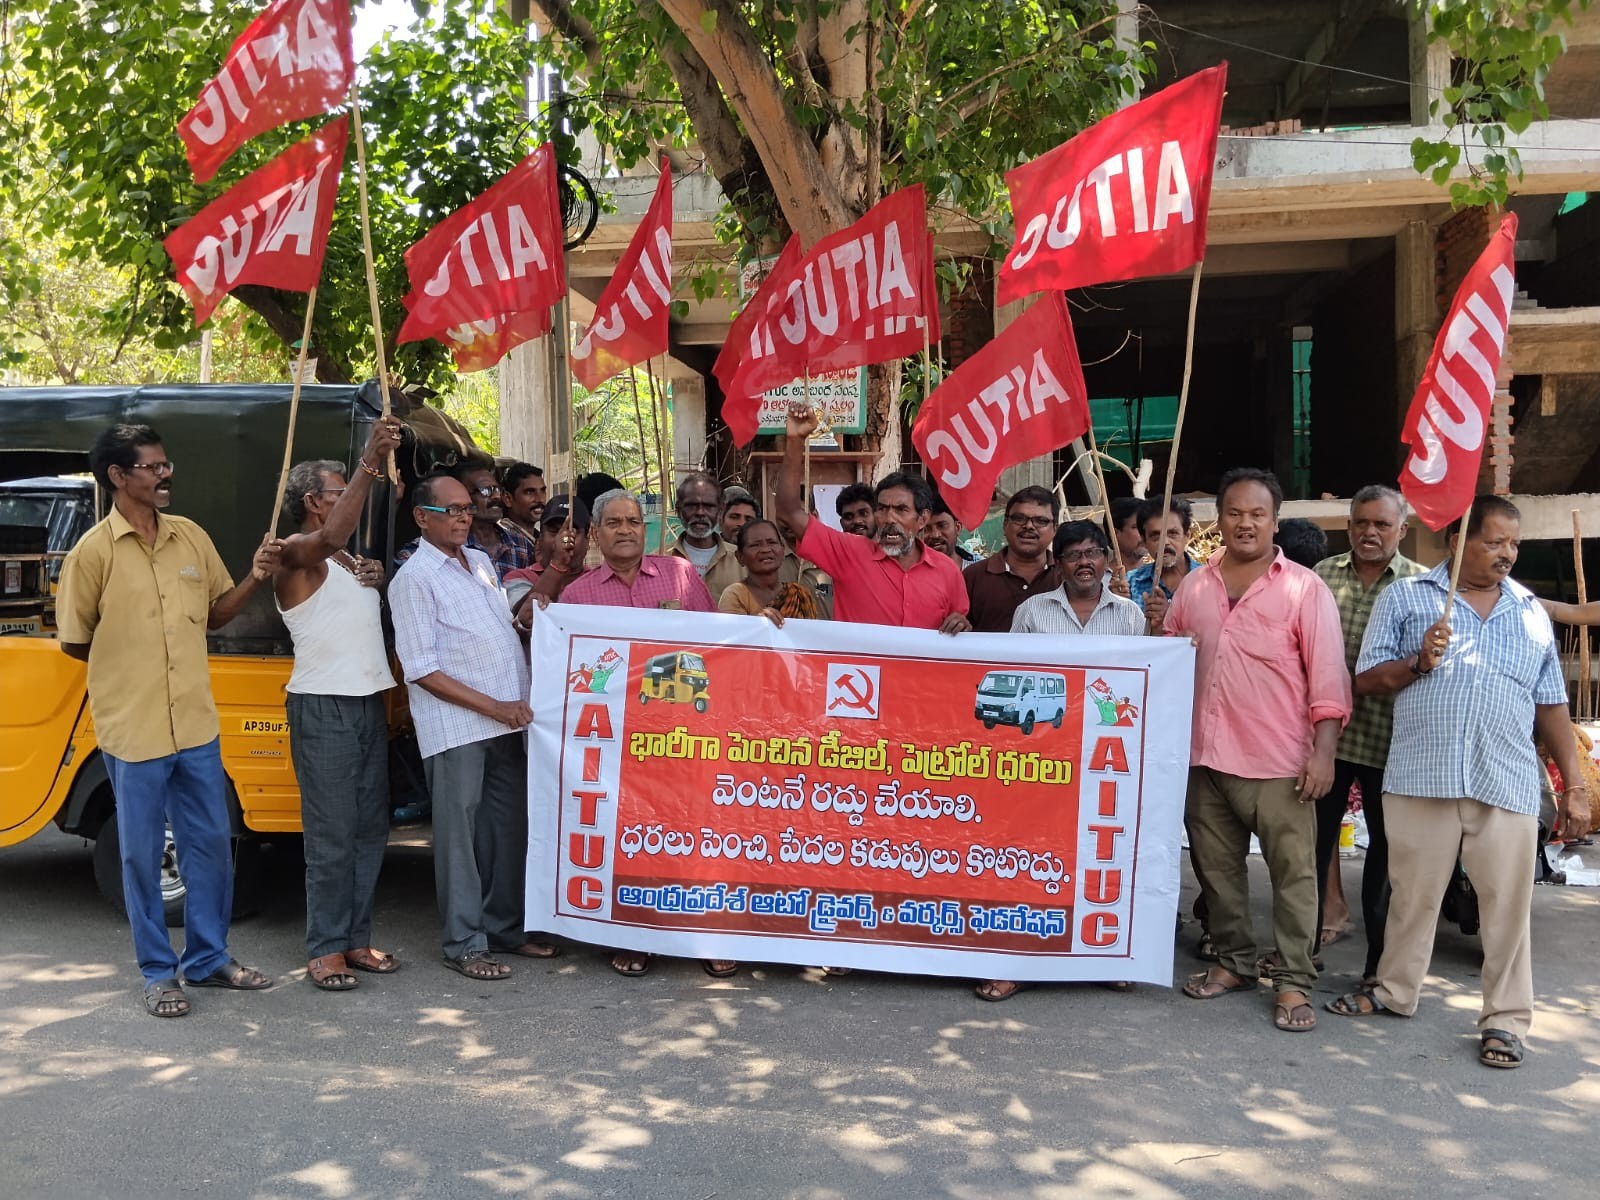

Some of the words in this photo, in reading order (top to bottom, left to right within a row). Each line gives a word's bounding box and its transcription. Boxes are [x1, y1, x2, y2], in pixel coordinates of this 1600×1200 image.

[629, 726, 721, 762] భారీగా
[727, 731, 812, 766] పెంచిన
[901, 741, 992, 781] పెట్రోల్
[996, 750, 1073, 786] ధరలు
[567, 703, 615, 912] AITUC
[712, 773, 806, 810] వెంటనే
[811, 782, 868, 827] రద్దు
[874, 779, 982, 823] చేయాలి.
[620, 823, 695, 859] ధరలు
[700, 827, 774, 865] పెంచి,
[778, 826, 845, 865] పేదల
[850, 837, 960, 879] కడుపులు
[1081, 736, 1131, 947] AITUC
[751, 889, 811, 916] ఆటో
[810, 893, 878, 932] డ్రైవర్స్
[882, 907, 895, 922] &
[899, 901, 964, 934] వర్కర్స్
[969, 904, 1066, 939] ఫెడరేషన్
